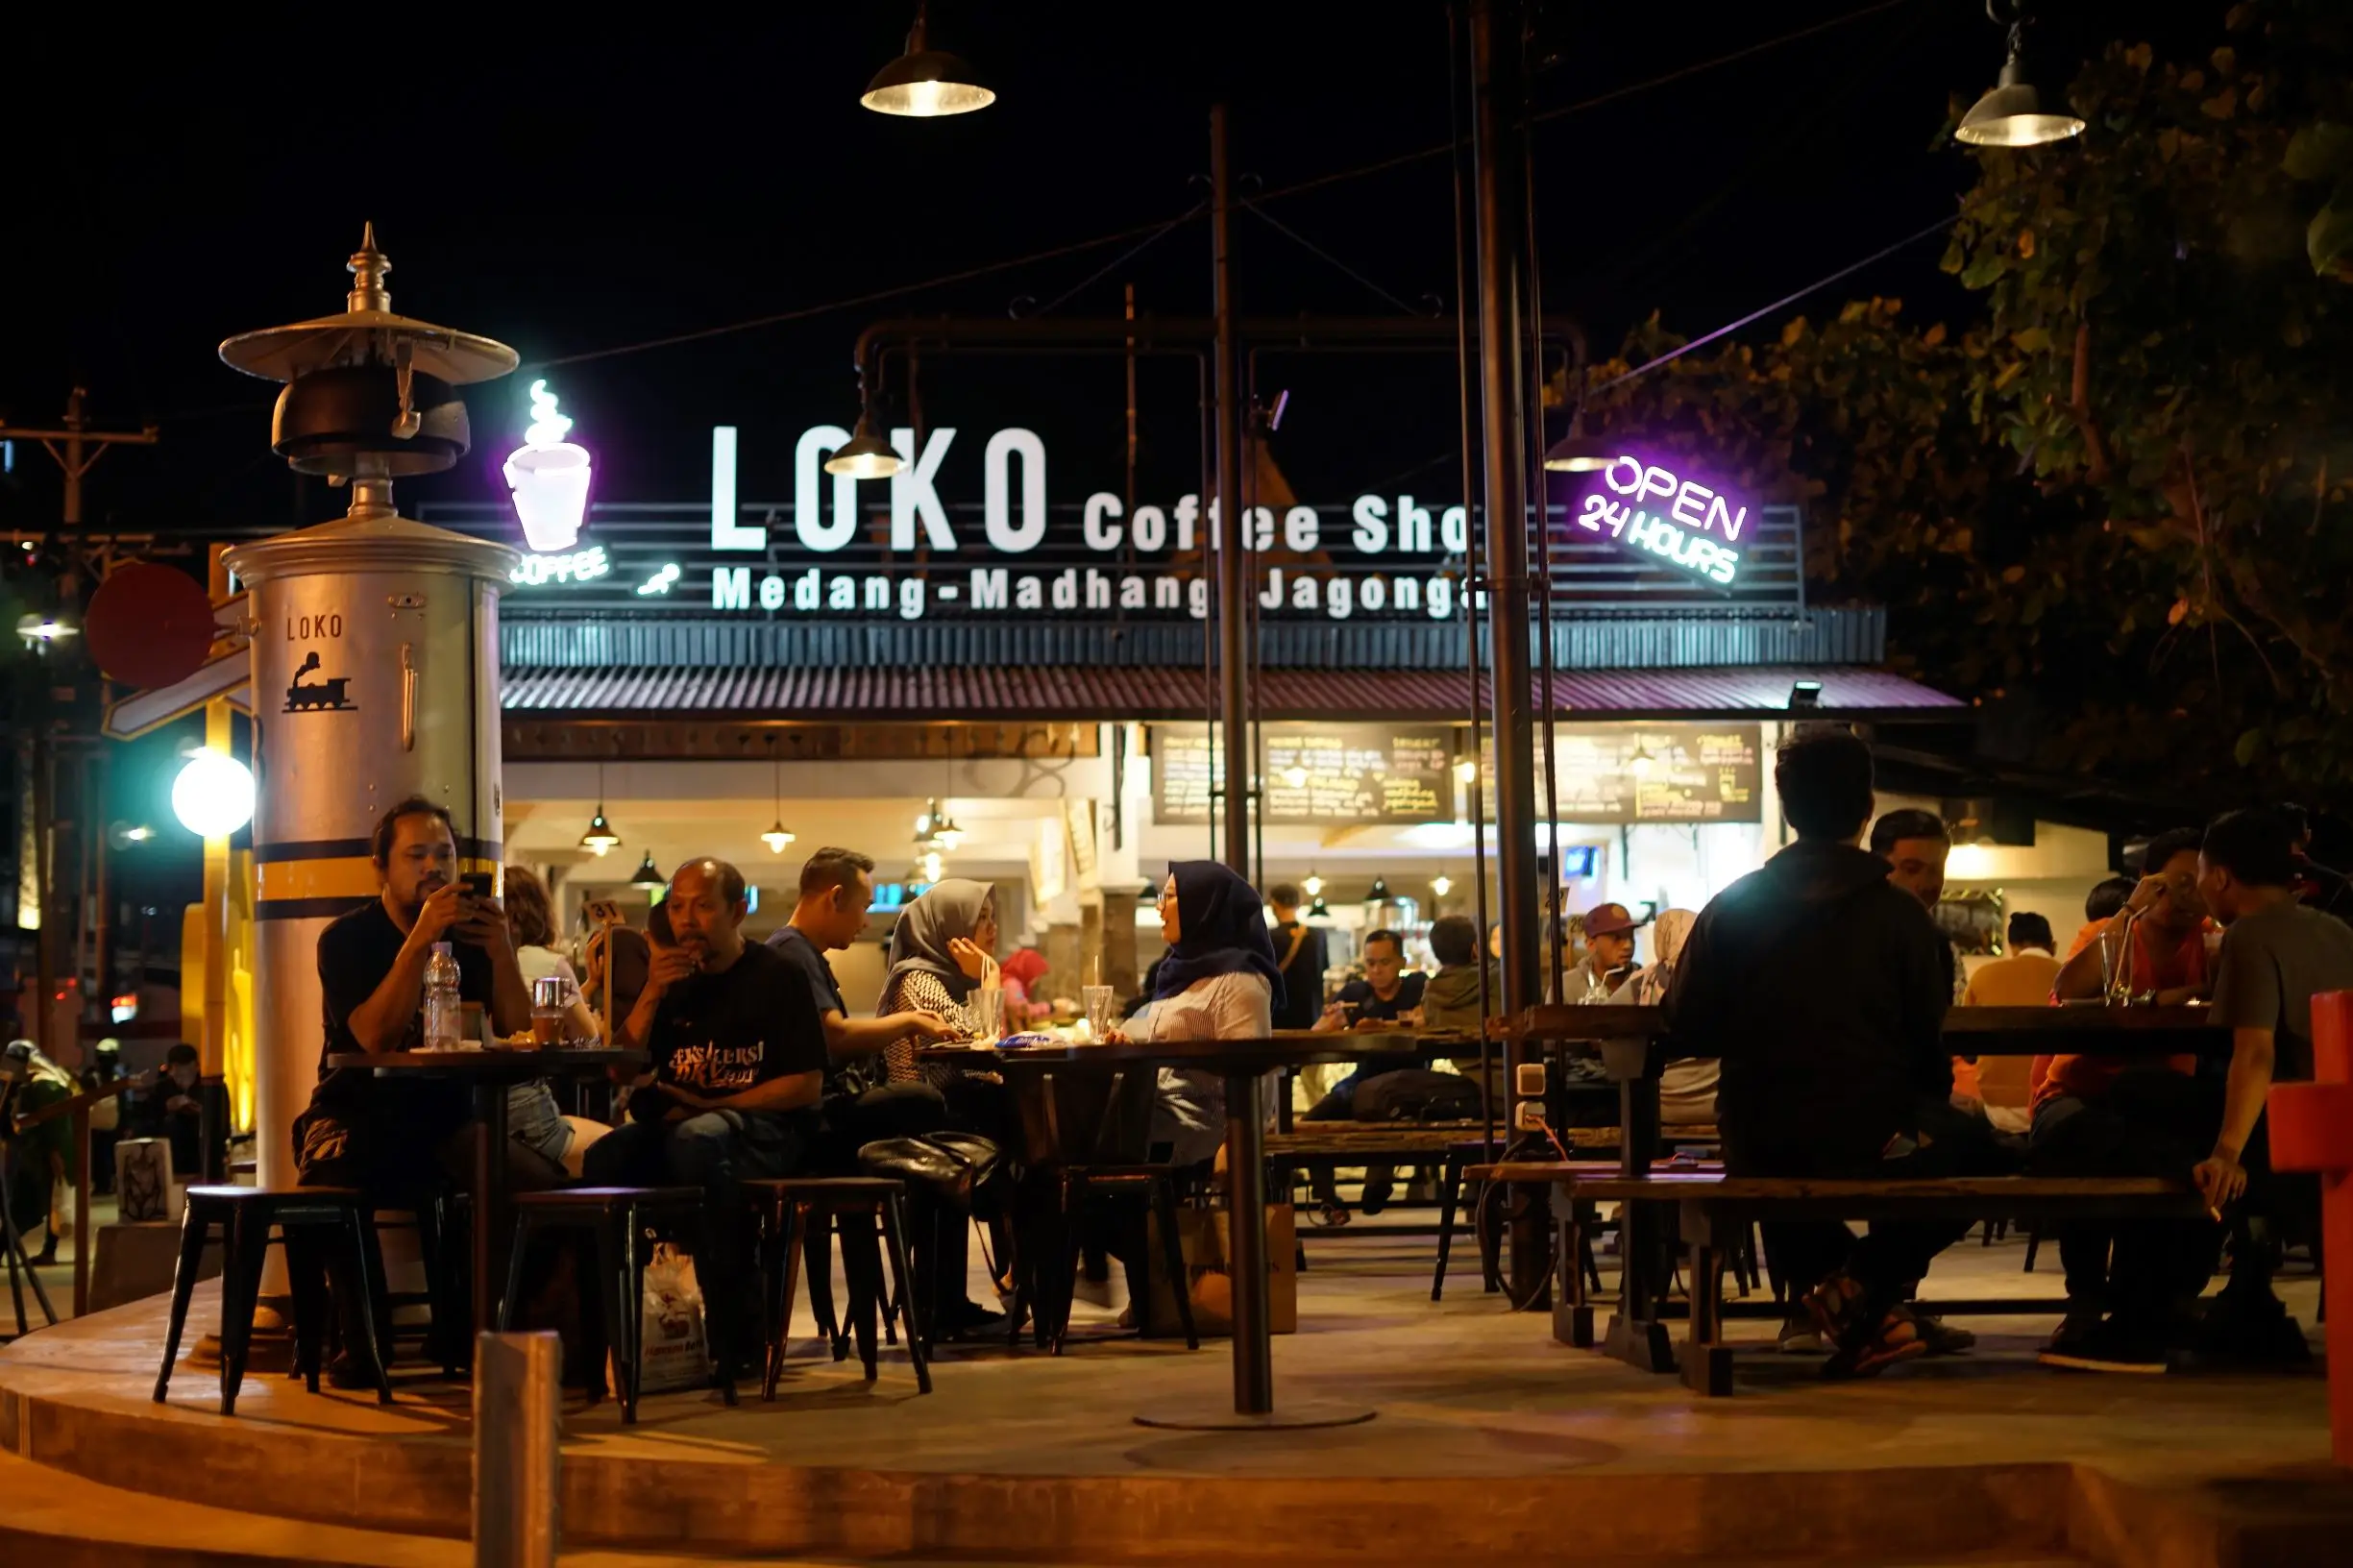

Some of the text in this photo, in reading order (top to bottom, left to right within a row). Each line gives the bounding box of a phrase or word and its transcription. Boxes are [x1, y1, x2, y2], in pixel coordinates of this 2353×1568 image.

[712, 426, 1046, 552] LOKO
[1352, 494, 1468, 554] Sho
[1605, 455, 1748, 541] OPEN
[1579, 494, 1739, 584] 24 HOURS
[1259, 568, 1487, 619] Jagonga
[287, 615, 342, 641] LOKO
[591, 902, 617, 919] 31
